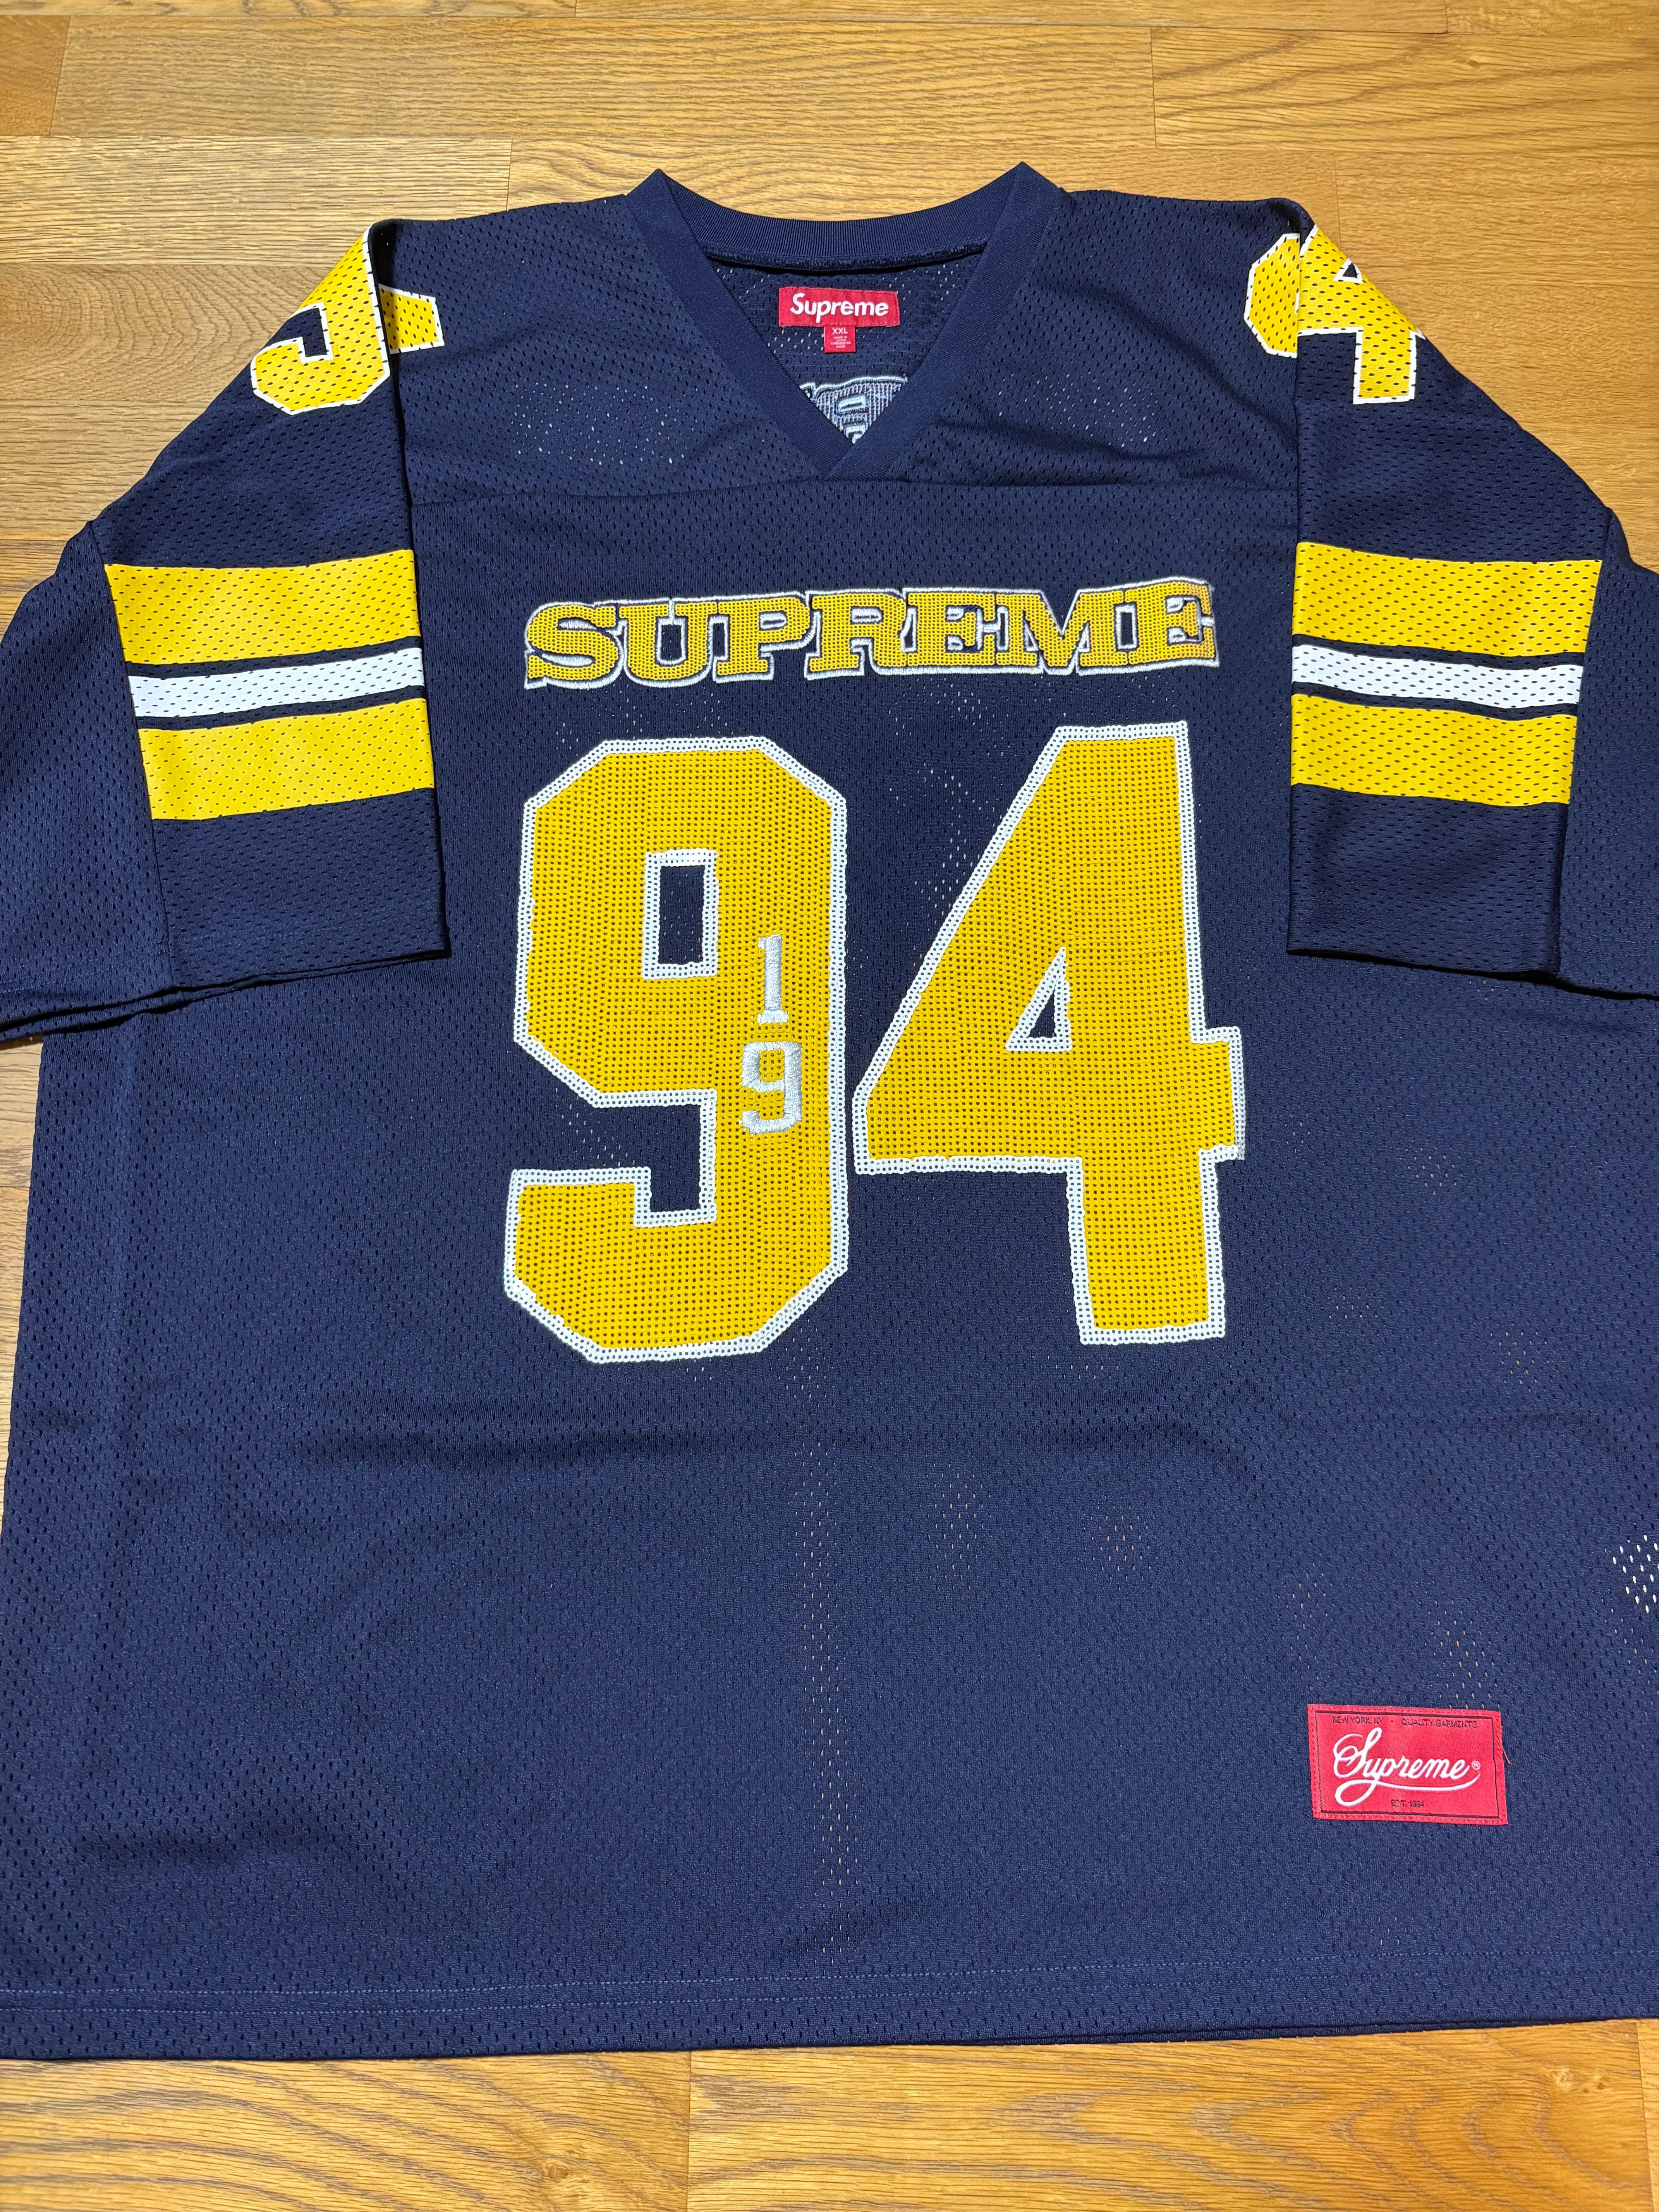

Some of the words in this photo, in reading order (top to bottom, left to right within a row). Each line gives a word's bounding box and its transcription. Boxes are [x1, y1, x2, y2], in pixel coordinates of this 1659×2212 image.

[790, 292, 889, 323] Supreme
[524, 576, 1220, 689] SUPREME
[504, 721, 1246, 1364] 94
[1401, 1717, 1433, 1726] QUALITY
[1435, 1719, 1477, 1728] GARMENTS
